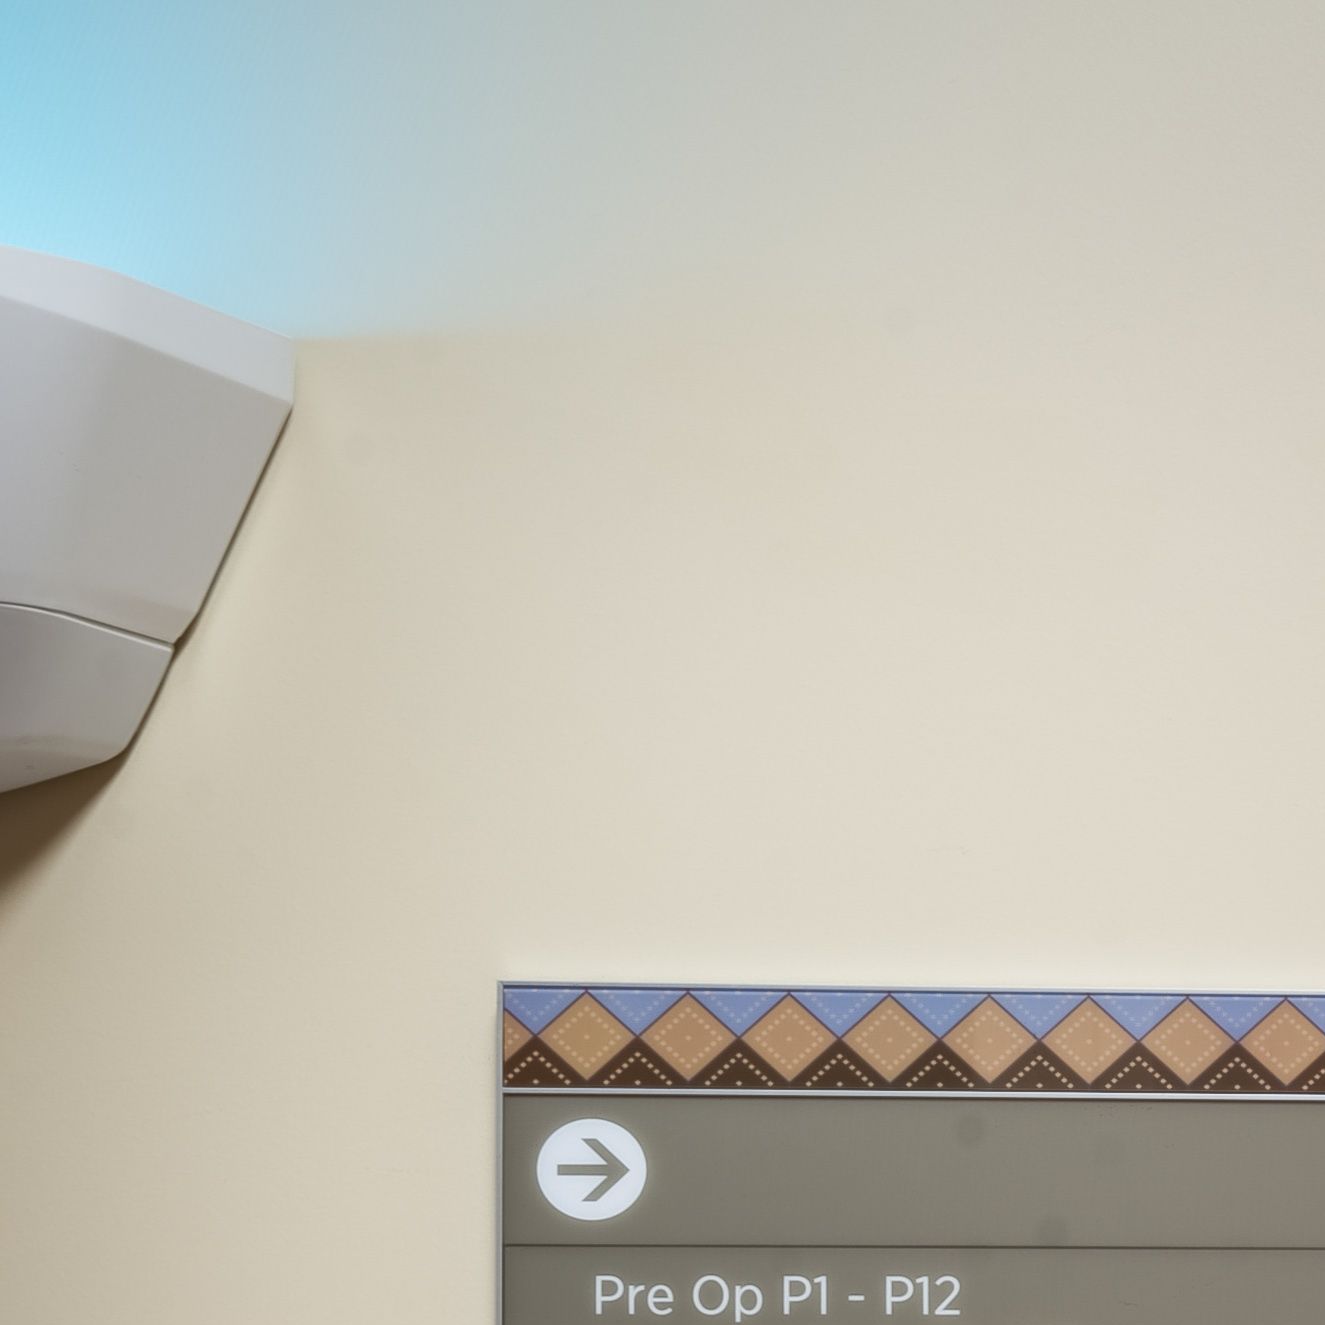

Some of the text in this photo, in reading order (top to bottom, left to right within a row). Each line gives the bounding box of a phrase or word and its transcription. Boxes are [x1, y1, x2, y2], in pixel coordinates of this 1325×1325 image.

[596, 1275, 962, 1324] Pre Op P1 - P12
